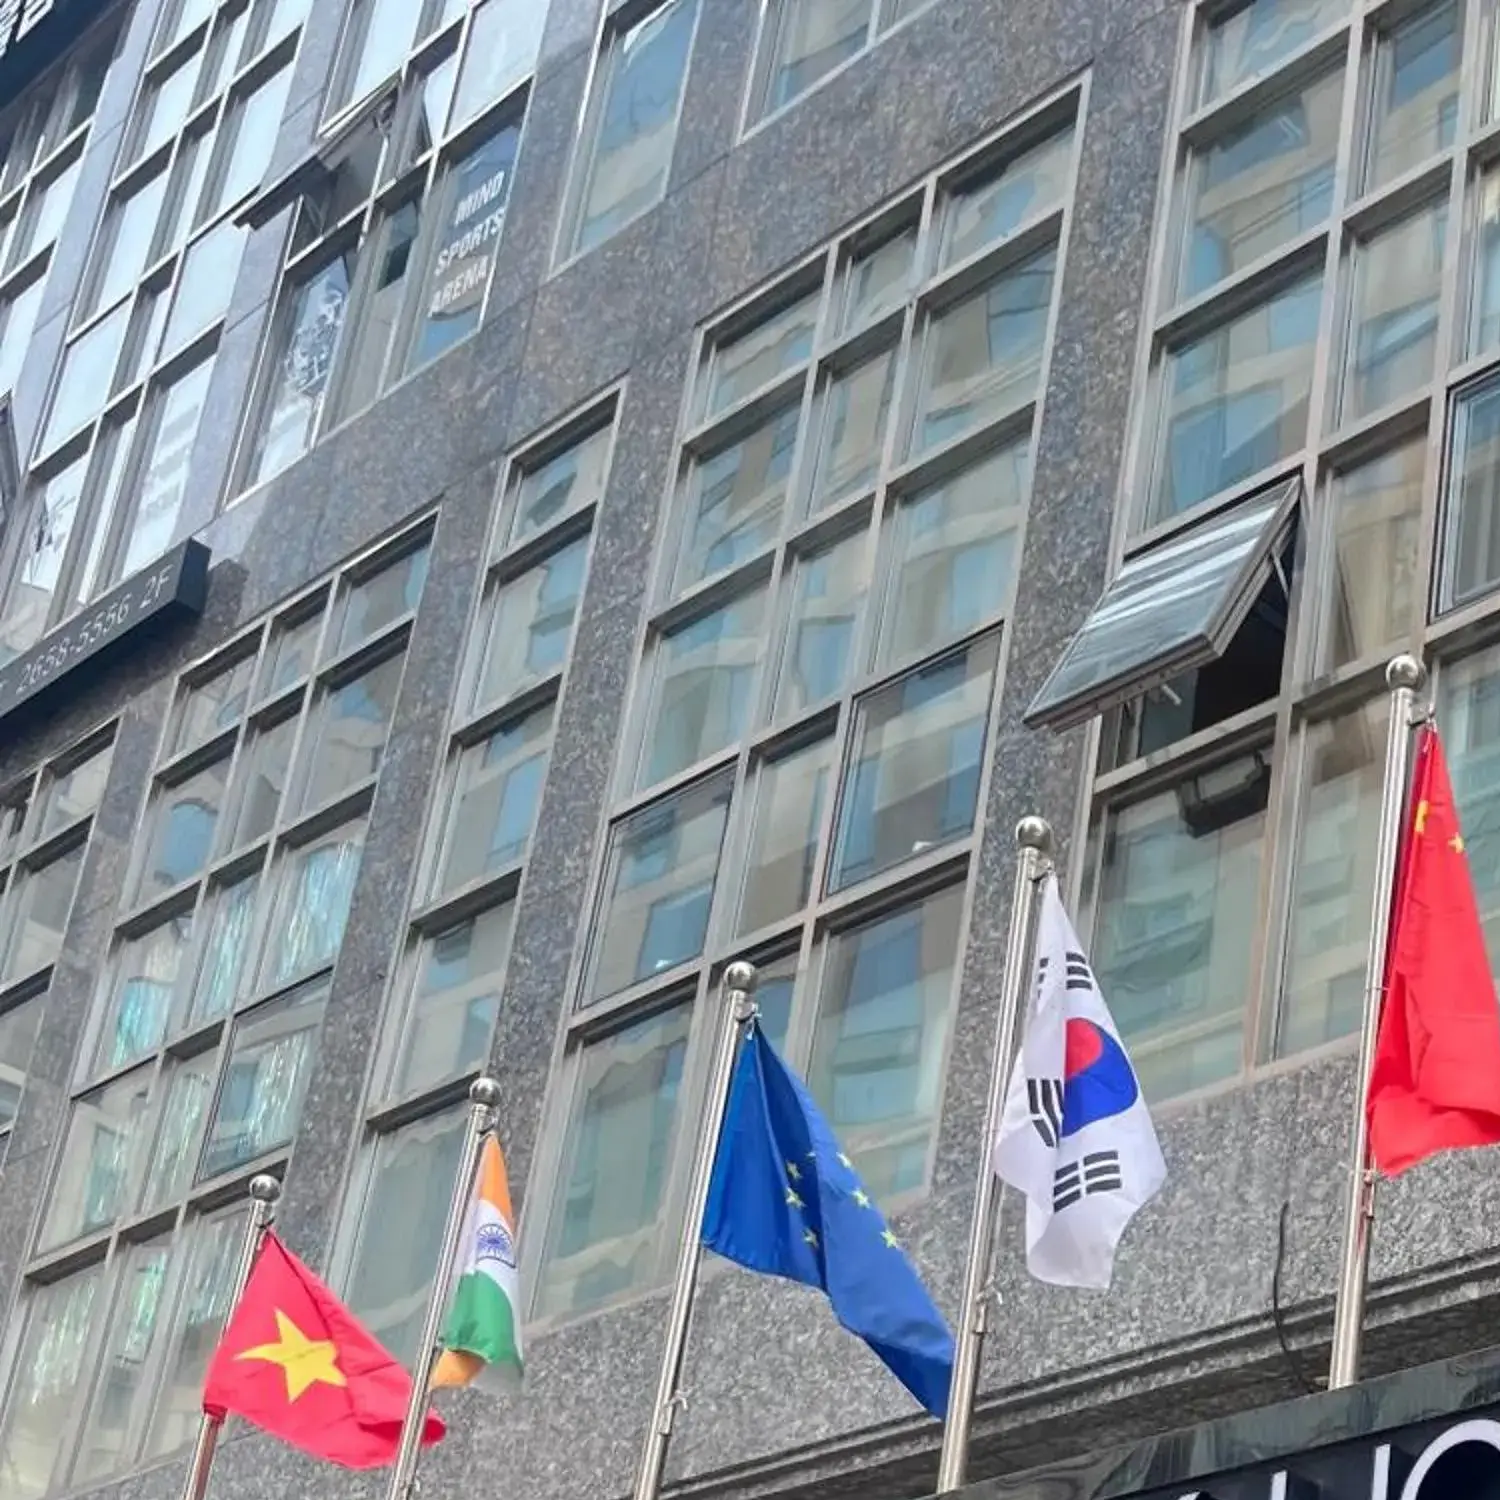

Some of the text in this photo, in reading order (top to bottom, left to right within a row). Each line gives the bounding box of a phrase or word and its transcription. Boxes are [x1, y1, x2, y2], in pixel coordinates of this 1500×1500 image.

[455, 171, 505, 227] MIND
[434, 207, 505, 276] SPORTS
[428, 255, 489, 318] ARENA
[140, 564, 174, 609] 2F
